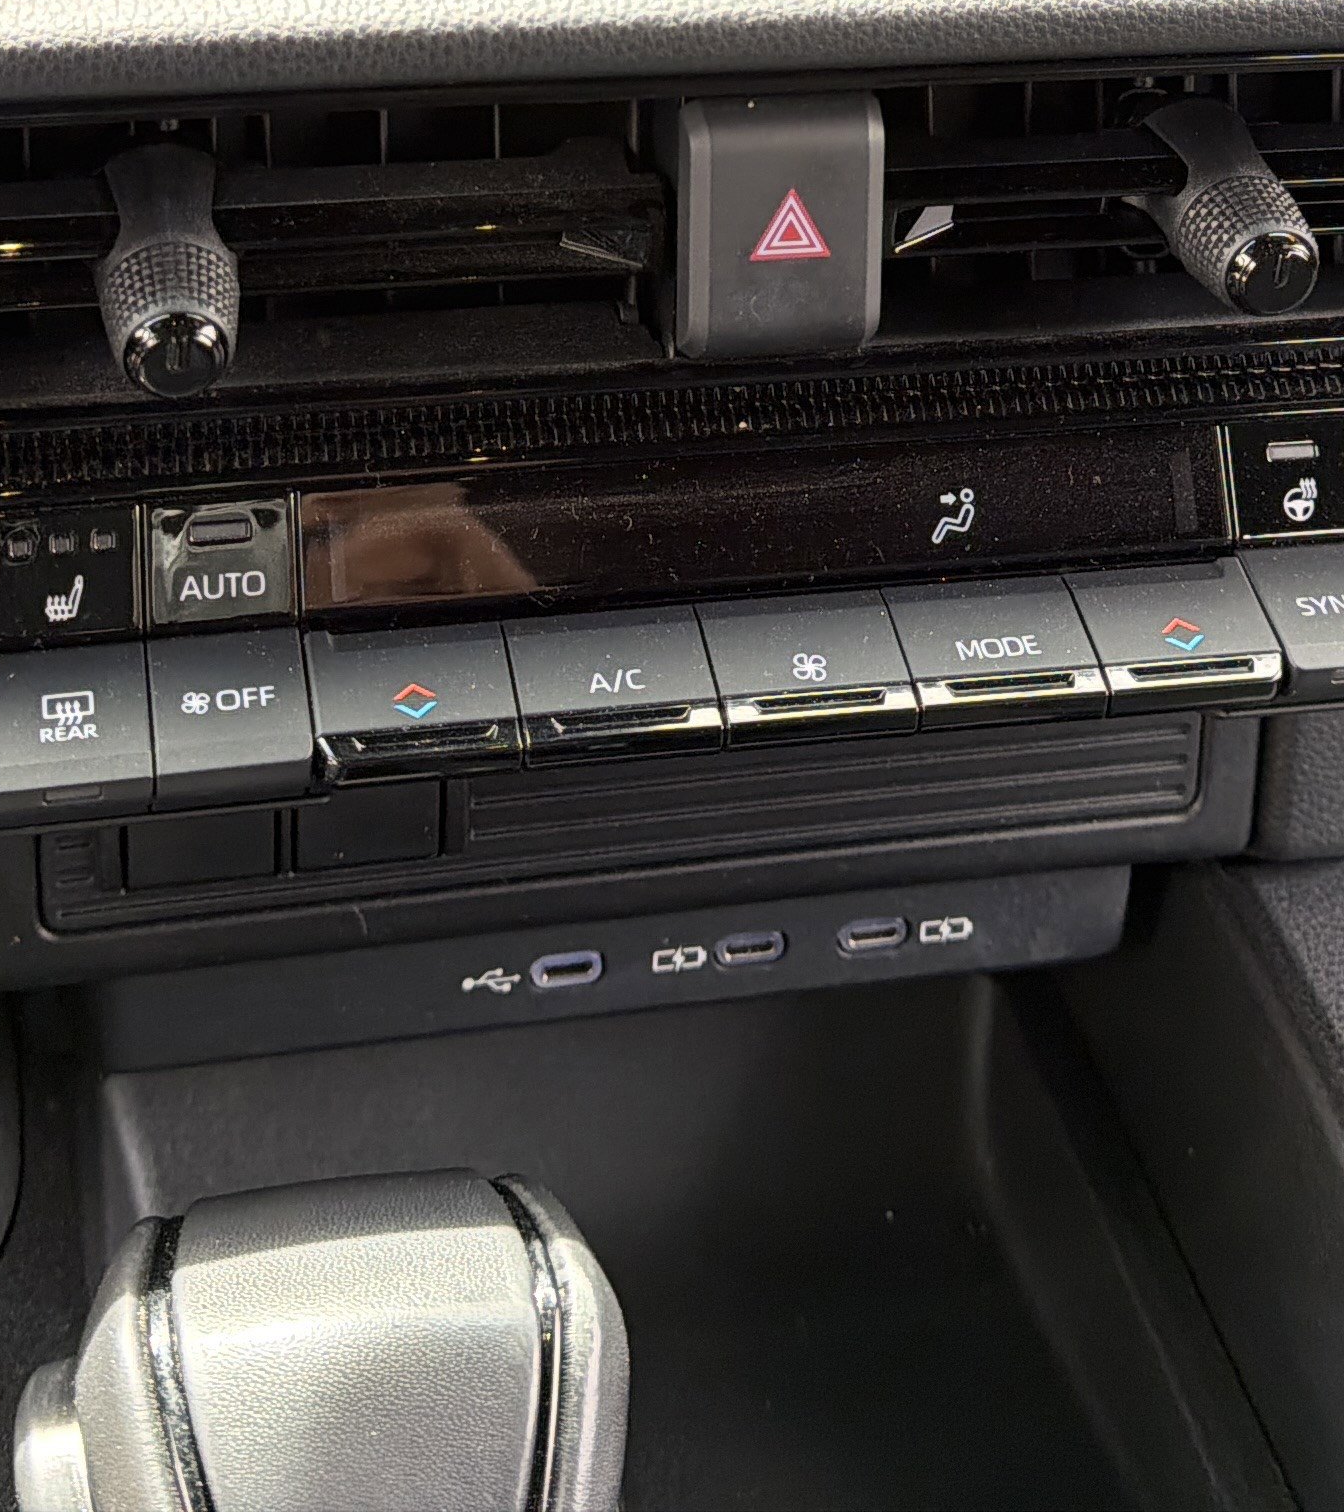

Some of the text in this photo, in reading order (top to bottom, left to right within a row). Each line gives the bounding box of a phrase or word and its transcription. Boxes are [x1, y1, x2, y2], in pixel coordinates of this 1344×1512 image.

[179, 569, 267, 602] AUTO
[954, 634, 1043, 661] MODE
[588, 667, 646, 695] A/C
[215, 685, 276, 713] OFF
[38, 722, 99, 744] REAR
